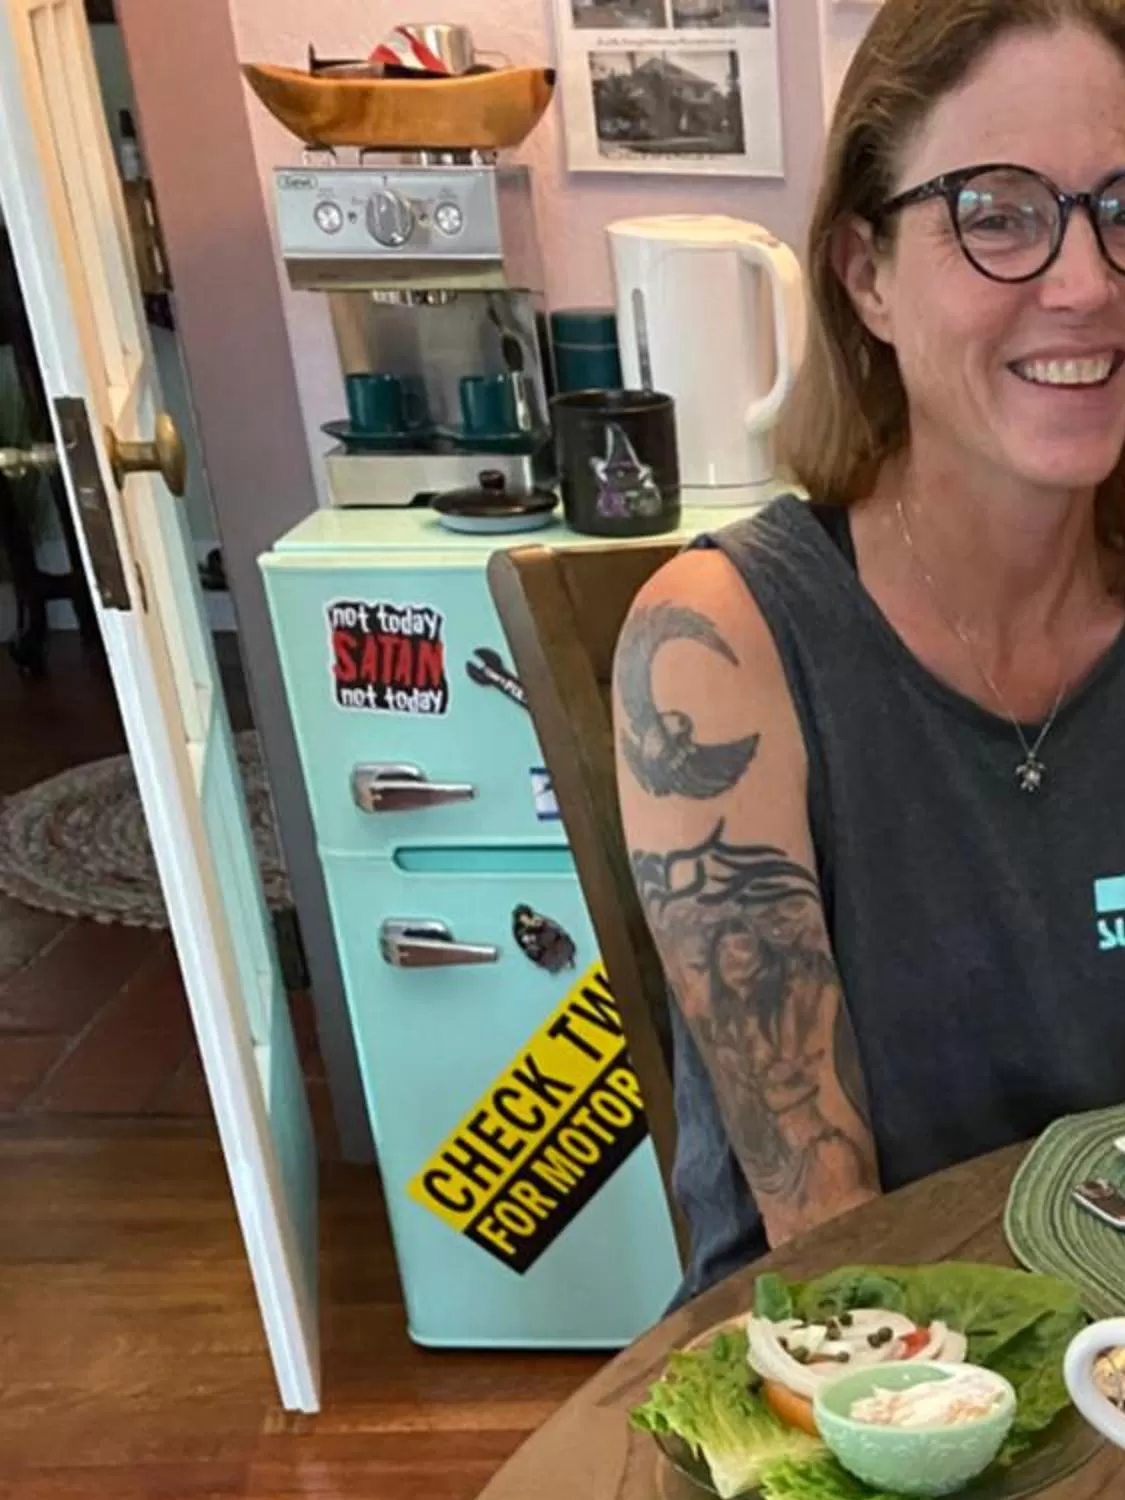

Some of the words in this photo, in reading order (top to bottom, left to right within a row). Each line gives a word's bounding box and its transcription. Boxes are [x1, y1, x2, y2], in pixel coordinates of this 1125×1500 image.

[332, 605, 369, 633] not
[377, 604, 437, 639] today
[332, 630, 444, 687] SATAN
[341, 684, 377, 708] not
[384, 686, 442, 713] today
[422, 1053, 576, 1215] CHECK
[476, 1179, 558, 1256] FOR
